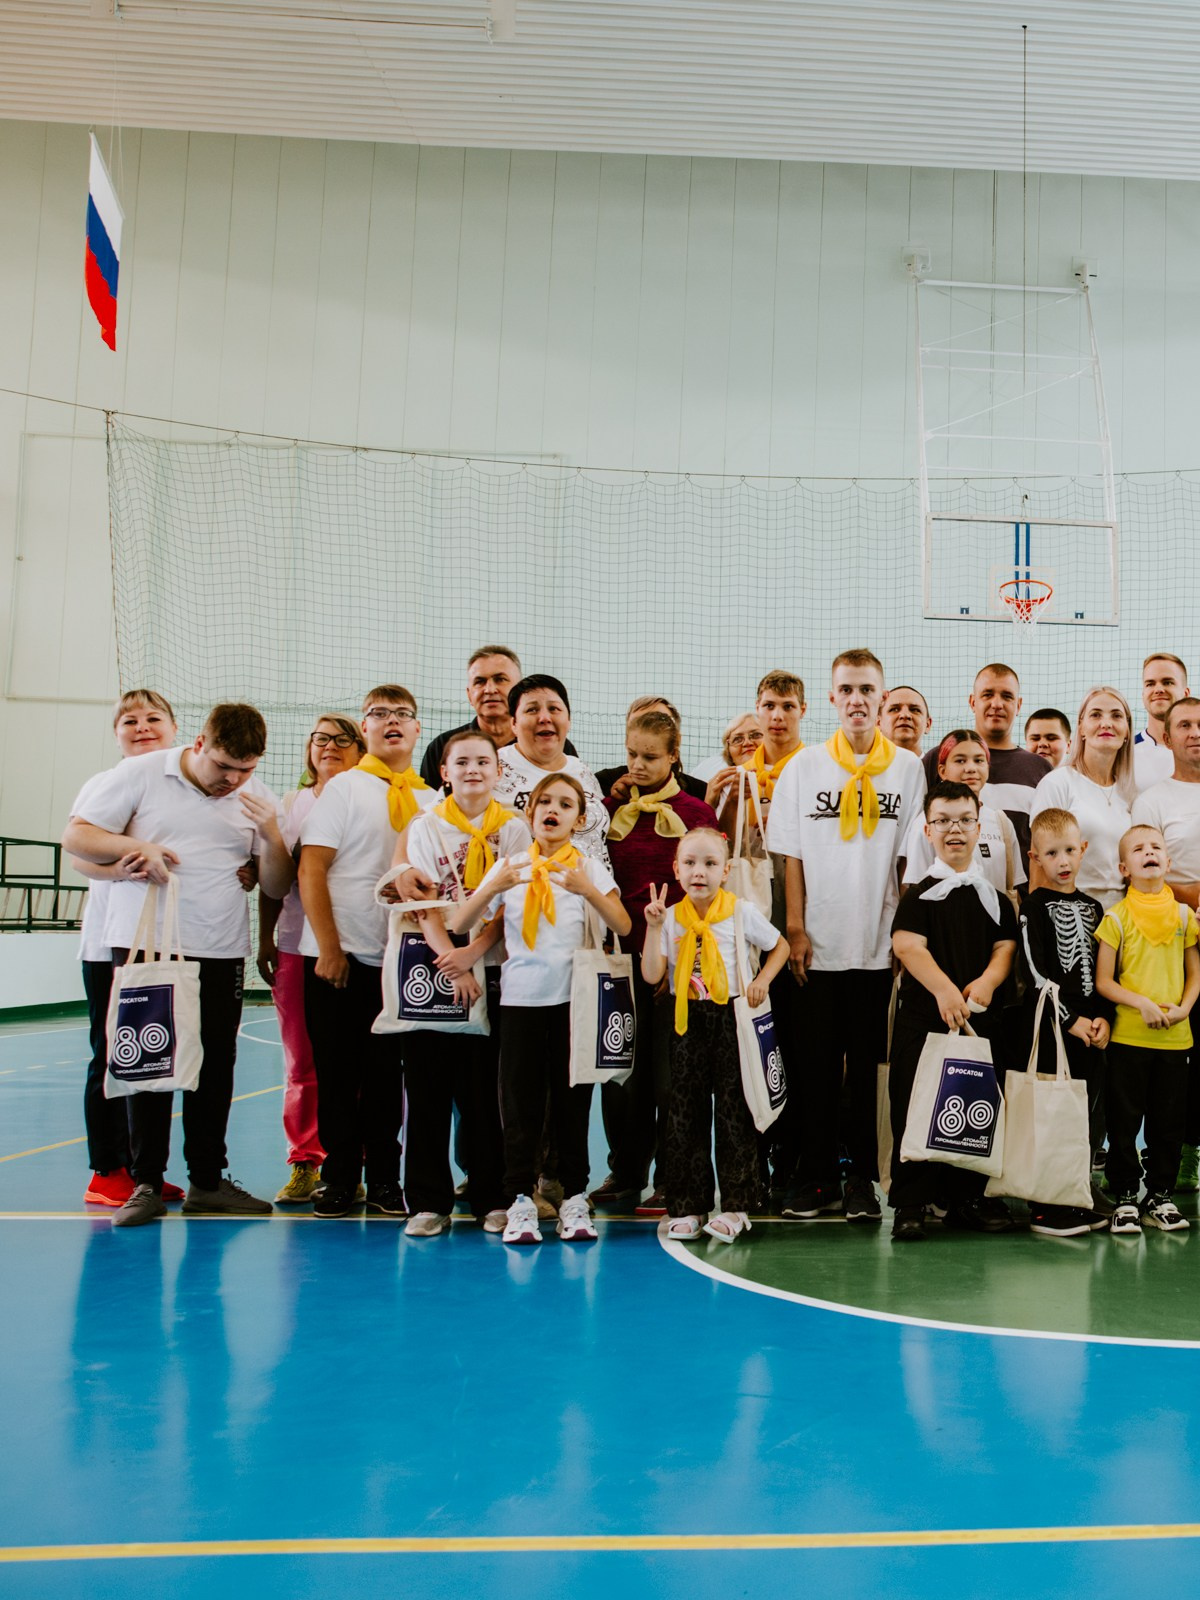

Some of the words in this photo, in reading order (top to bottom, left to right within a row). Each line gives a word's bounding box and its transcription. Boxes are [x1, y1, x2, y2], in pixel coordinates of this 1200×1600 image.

[113, 1022, 170, 1068] 80
[955, 1067, 984, 1078] РОСАТОМ
[937, 1095, 995, 1137] 80
